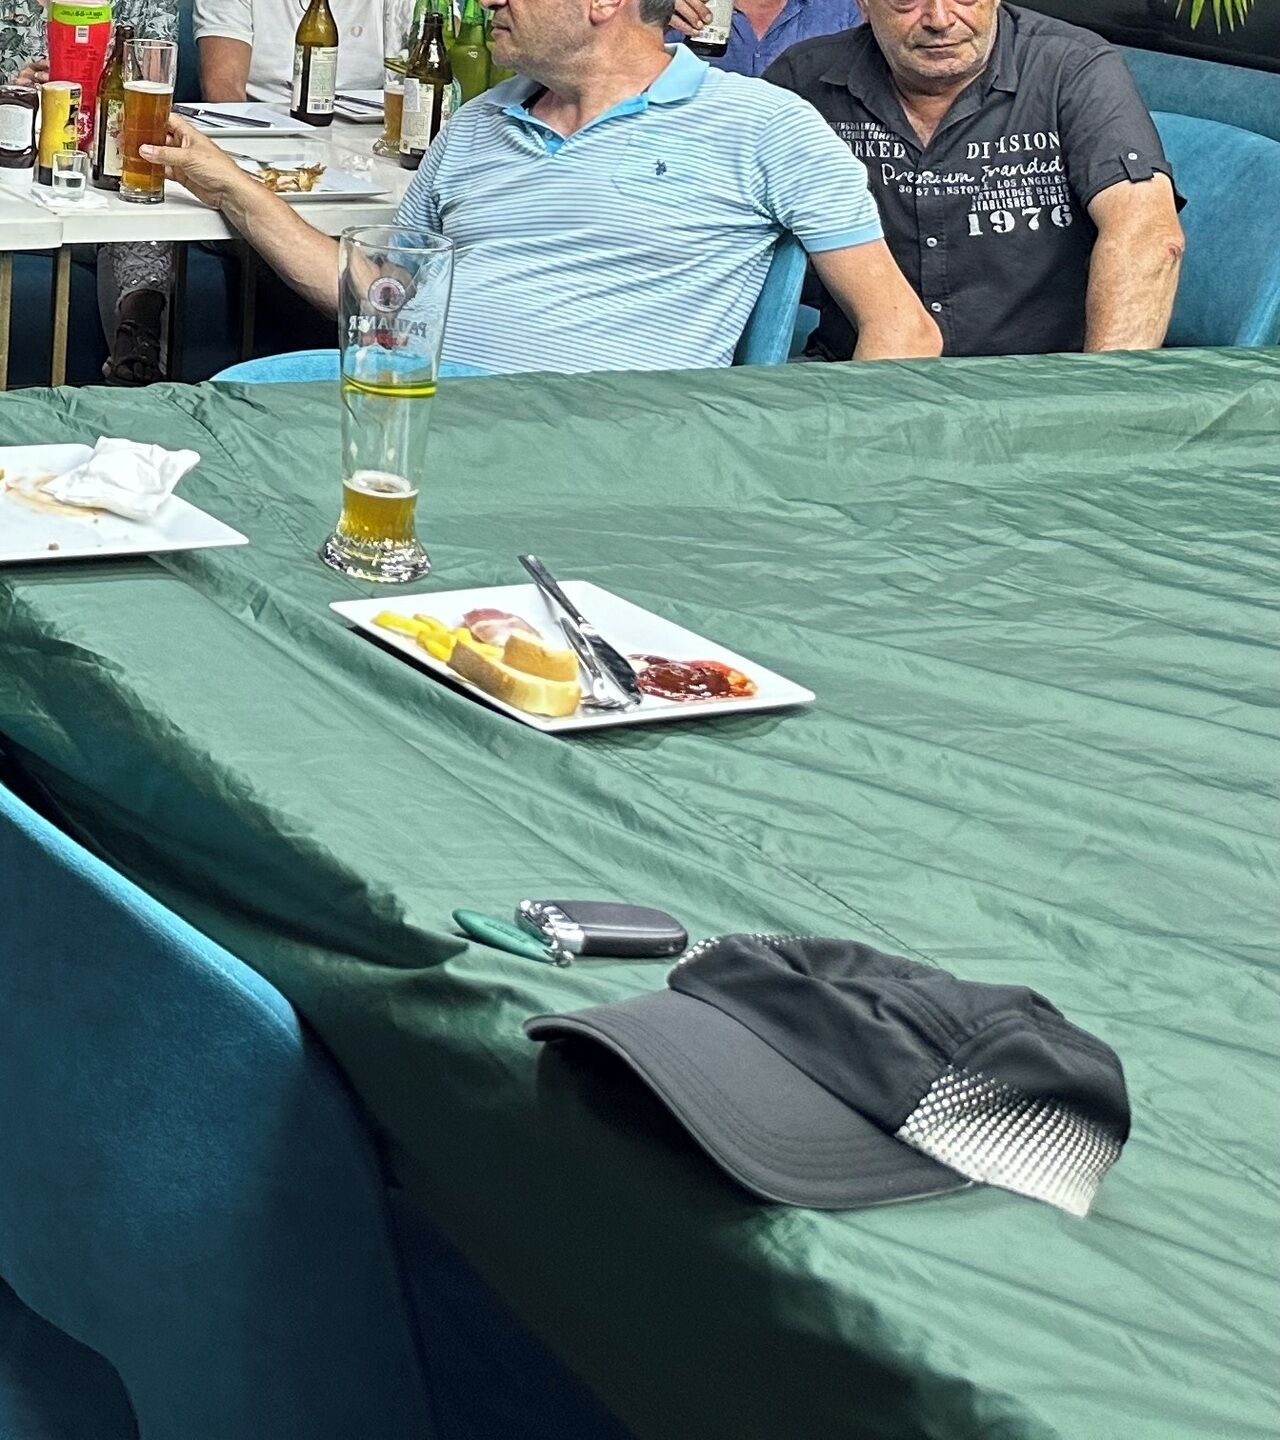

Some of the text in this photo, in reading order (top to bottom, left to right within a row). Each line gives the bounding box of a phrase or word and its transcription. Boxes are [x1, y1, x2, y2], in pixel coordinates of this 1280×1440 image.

[997, 179, 1017, 190] LOS
[1021, 175, 1068, 188] ANGELES
[1039, 192, 1071, 206] SINCE
[967, 204, 1074, 236] 1976
